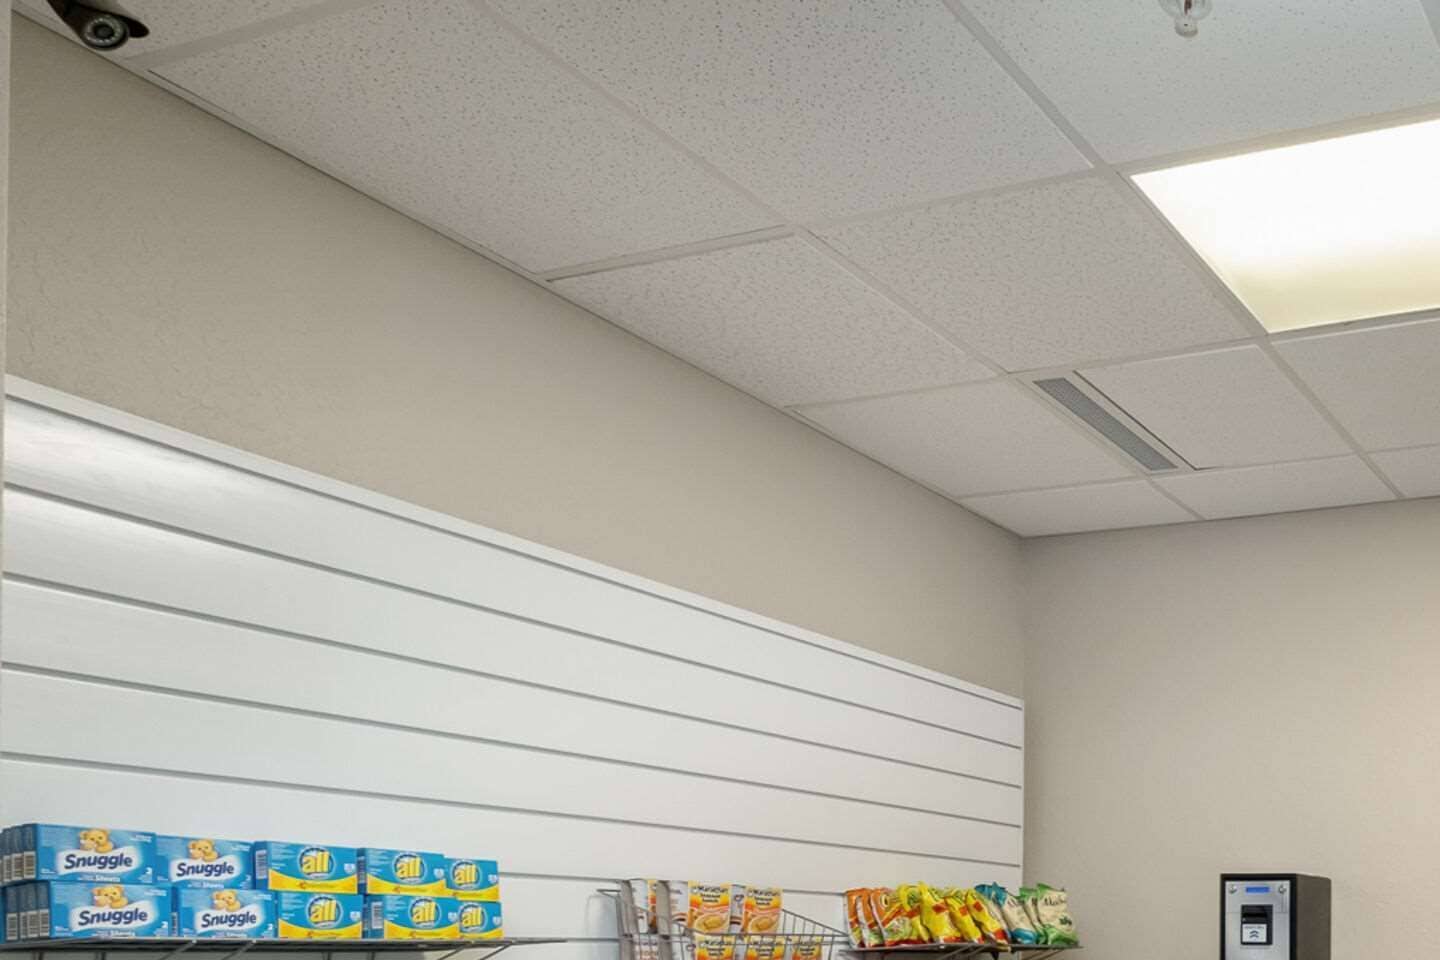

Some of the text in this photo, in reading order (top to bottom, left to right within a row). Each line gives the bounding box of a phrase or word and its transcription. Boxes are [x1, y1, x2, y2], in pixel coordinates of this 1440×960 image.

[64, 853, 133, 870] Snuggle
[176, 862, 235, 877] Snuggle
[303, 850, 330, 873] all
[395, 855, 421, 878] all
[453, 863, 477, 883] all
[78, 908, 149, 926] Snuggle
[202, 911, 257, 928] Snuggle
[310, 899, 337, 922] all
[412, 900, 436, 923] all
[461, 906, 482, 927] all
